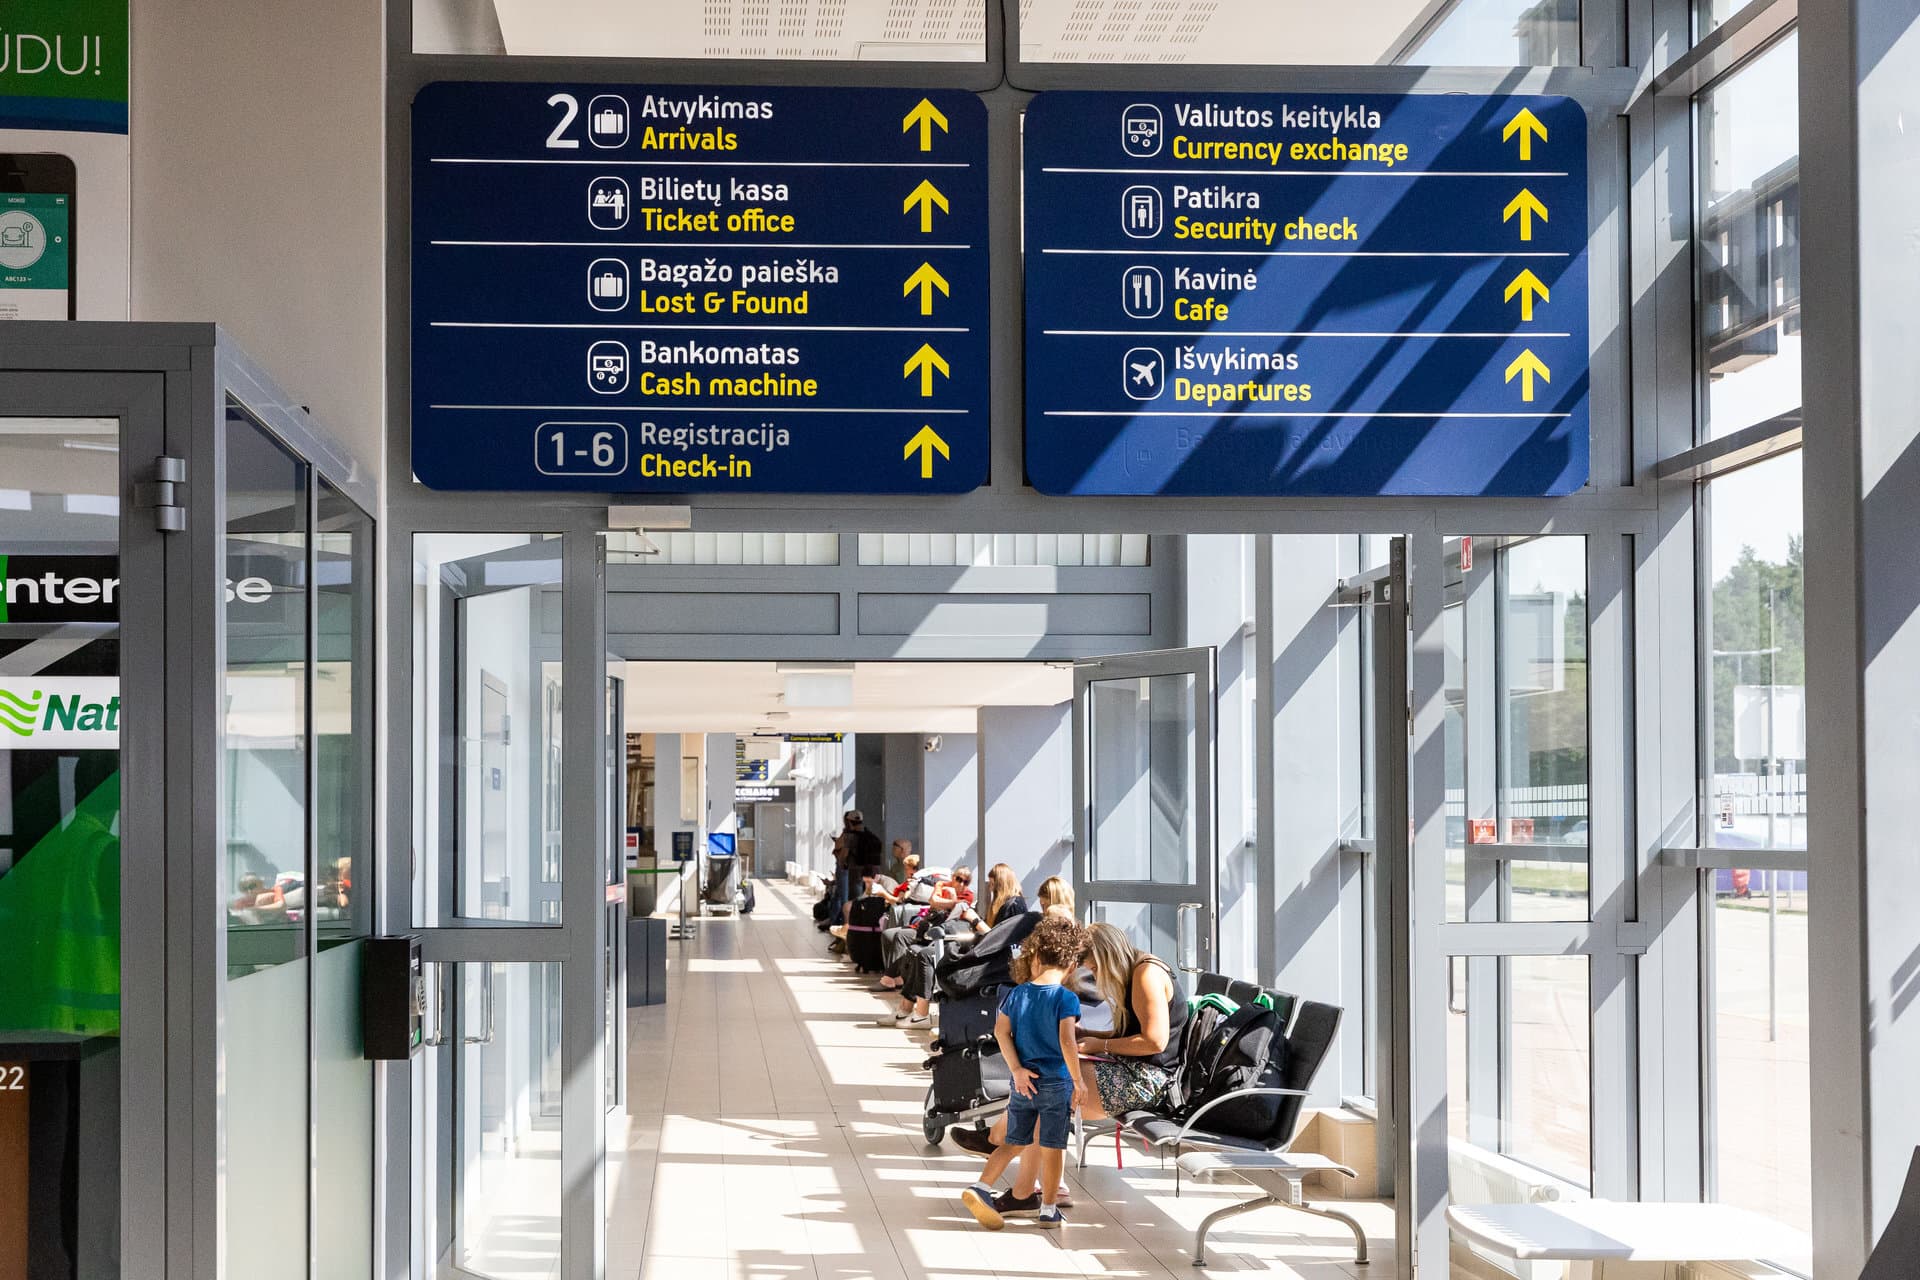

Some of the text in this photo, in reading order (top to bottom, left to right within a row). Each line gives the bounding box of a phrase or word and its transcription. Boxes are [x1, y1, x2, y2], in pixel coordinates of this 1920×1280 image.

[545, 93, 580, 149] 2
[641, 94, 774, 124] Atvykimas
[1174, 103, 1381, 135] Valiutos keitykla
[641, 126, 738, 151] Arrivals
[1173, 136, 1409, 167] Currency exchange
[641, 177, 790, 207] Bilietų kasa
[1173, 186, 1260, 209] Patikra
[641, 207, 796, 232] Ticket office
[1174, 216, 1358, 245] Security check
[640, 258, 840, 289] Bagažo paieška
[1174, 267, 1258, 291] Kavinė
[640, 290, 809, 314] Lost & Found
[1174, 297, 1230, 322] Cafe
[640, 340, 800, 365] Bankomatas
[1175, 346, 1299, 376] Išvykimas
[640, 372, 818, 396] Cash machine
[1175, 379, 1312, 407] Departures
[550, 432, 615, 467] 1-6
[641, 422, 791, 452] Registracija
[640, 454, 752, 478] Check-in
[42, 694, 120, 731] Nat
